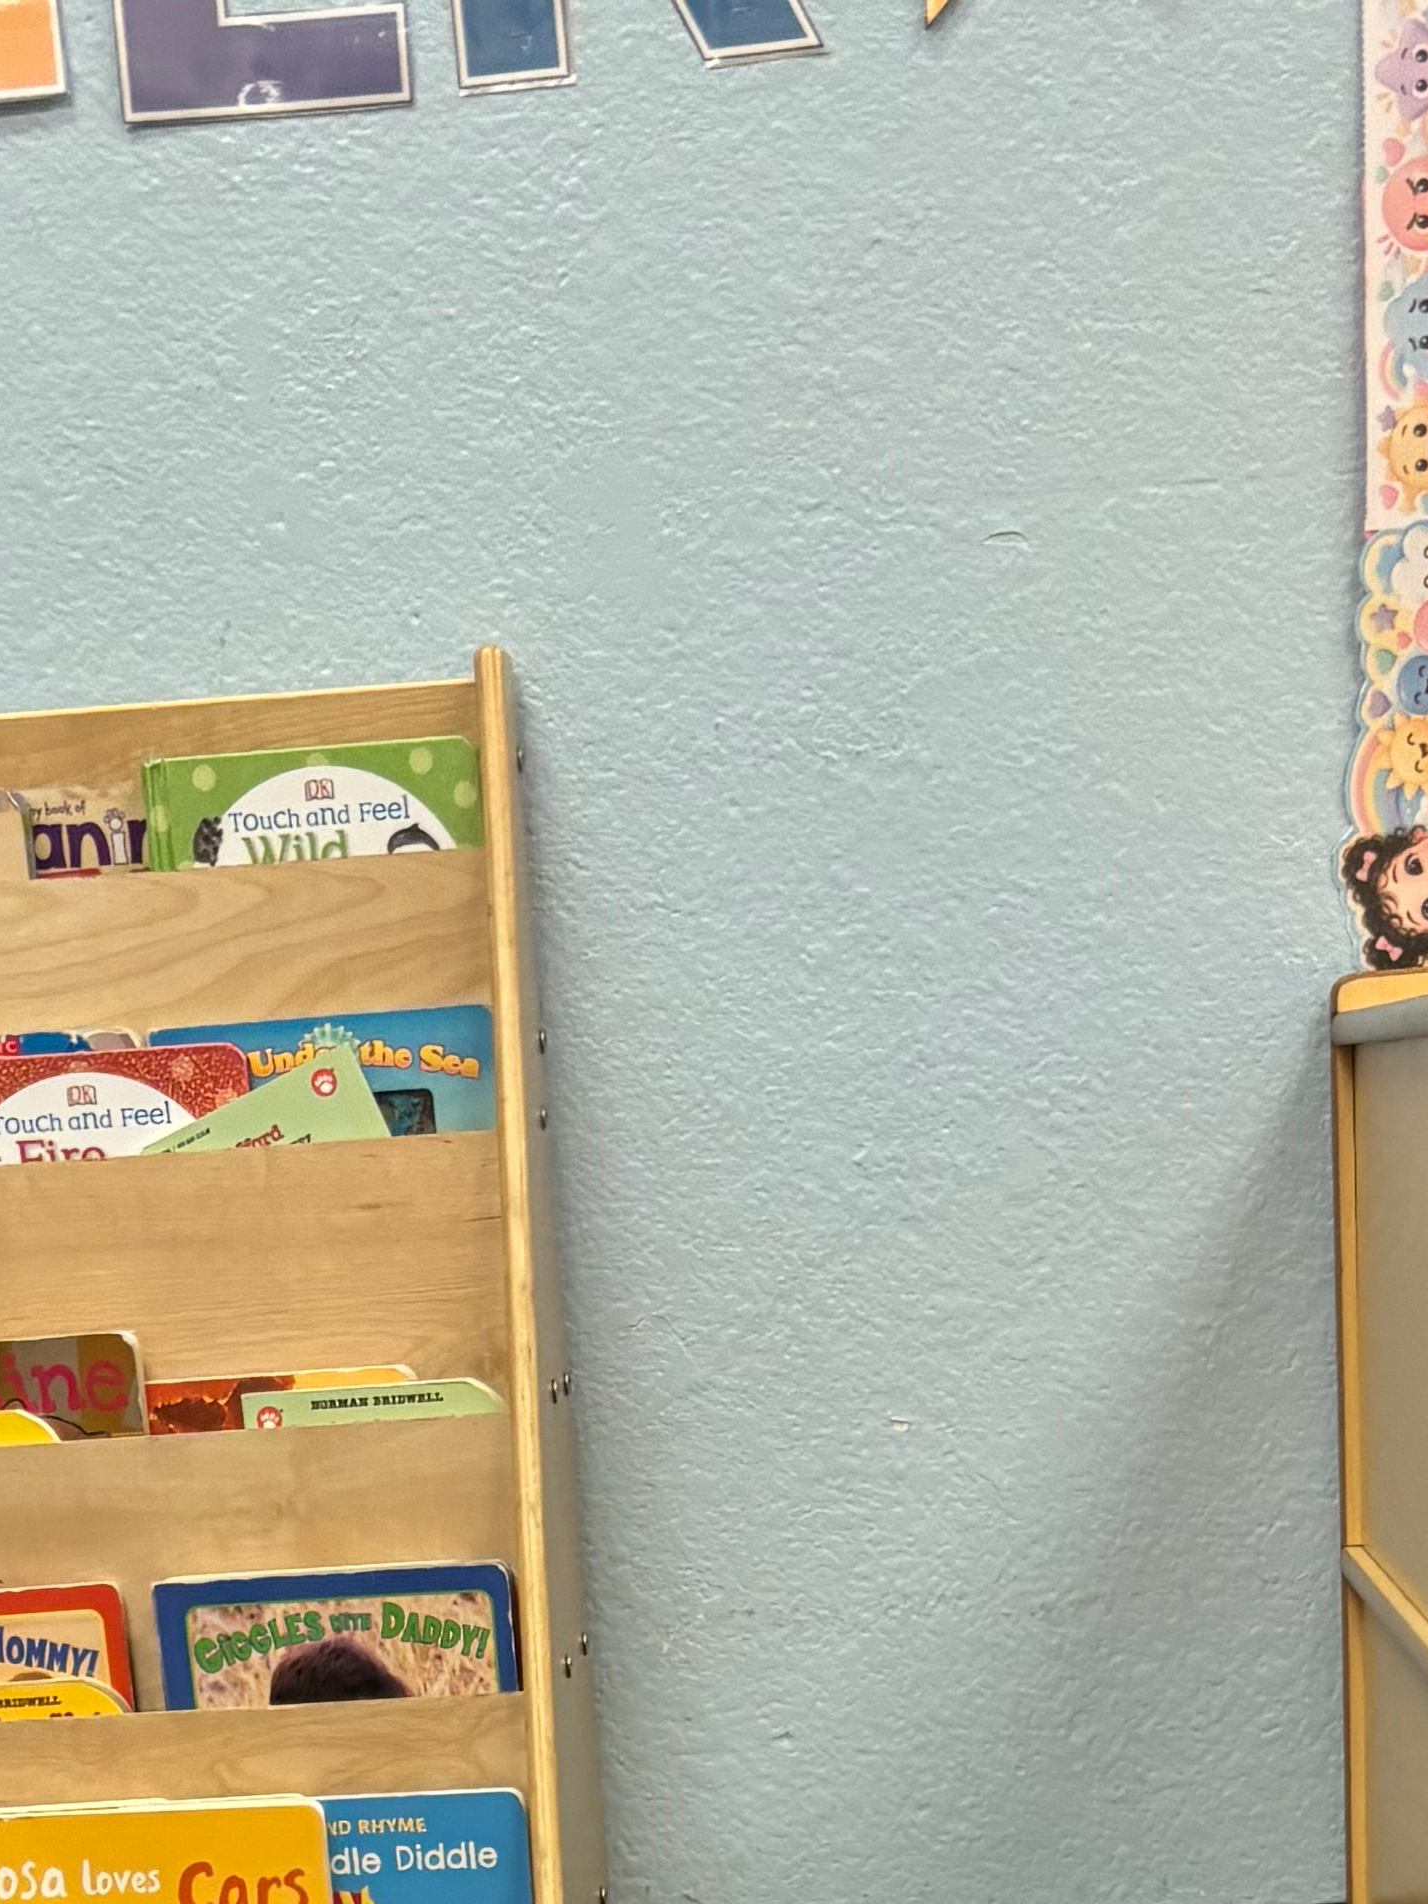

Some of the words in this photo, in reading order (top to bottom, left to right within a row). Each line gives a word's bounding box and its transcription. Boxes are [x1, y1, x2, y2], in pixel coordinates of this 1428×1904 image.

[305, 779, 334, 801] DK
[45, 801, 72, 816] book
[229, 809, 301, 834] Touch
[306, 804, 351, 827] and
[359, 794, 411, 823] Feel
[241, 829, 350, 865] Wild
[358, 1039, 413, 1069] the
[419, 1044, 482, 1080] Sea
[67, 1084, 97, 1106] DK
[67, 1108, 114, 1132] and
[121, 1100, 172, 1128] Feel
[373, 1392, 444, 1407] BRIDWELL
[193, 1610, 325, 1674] GIGGLES
[380, 1600, 491, 1660] DADDY!
[358, 1817, 428, 1835] RHYME
[331, 1846, 382, 1876] dle
[395, 1840, 499, 1872] Diddle
[82, 1858, 161, 1897] loves
